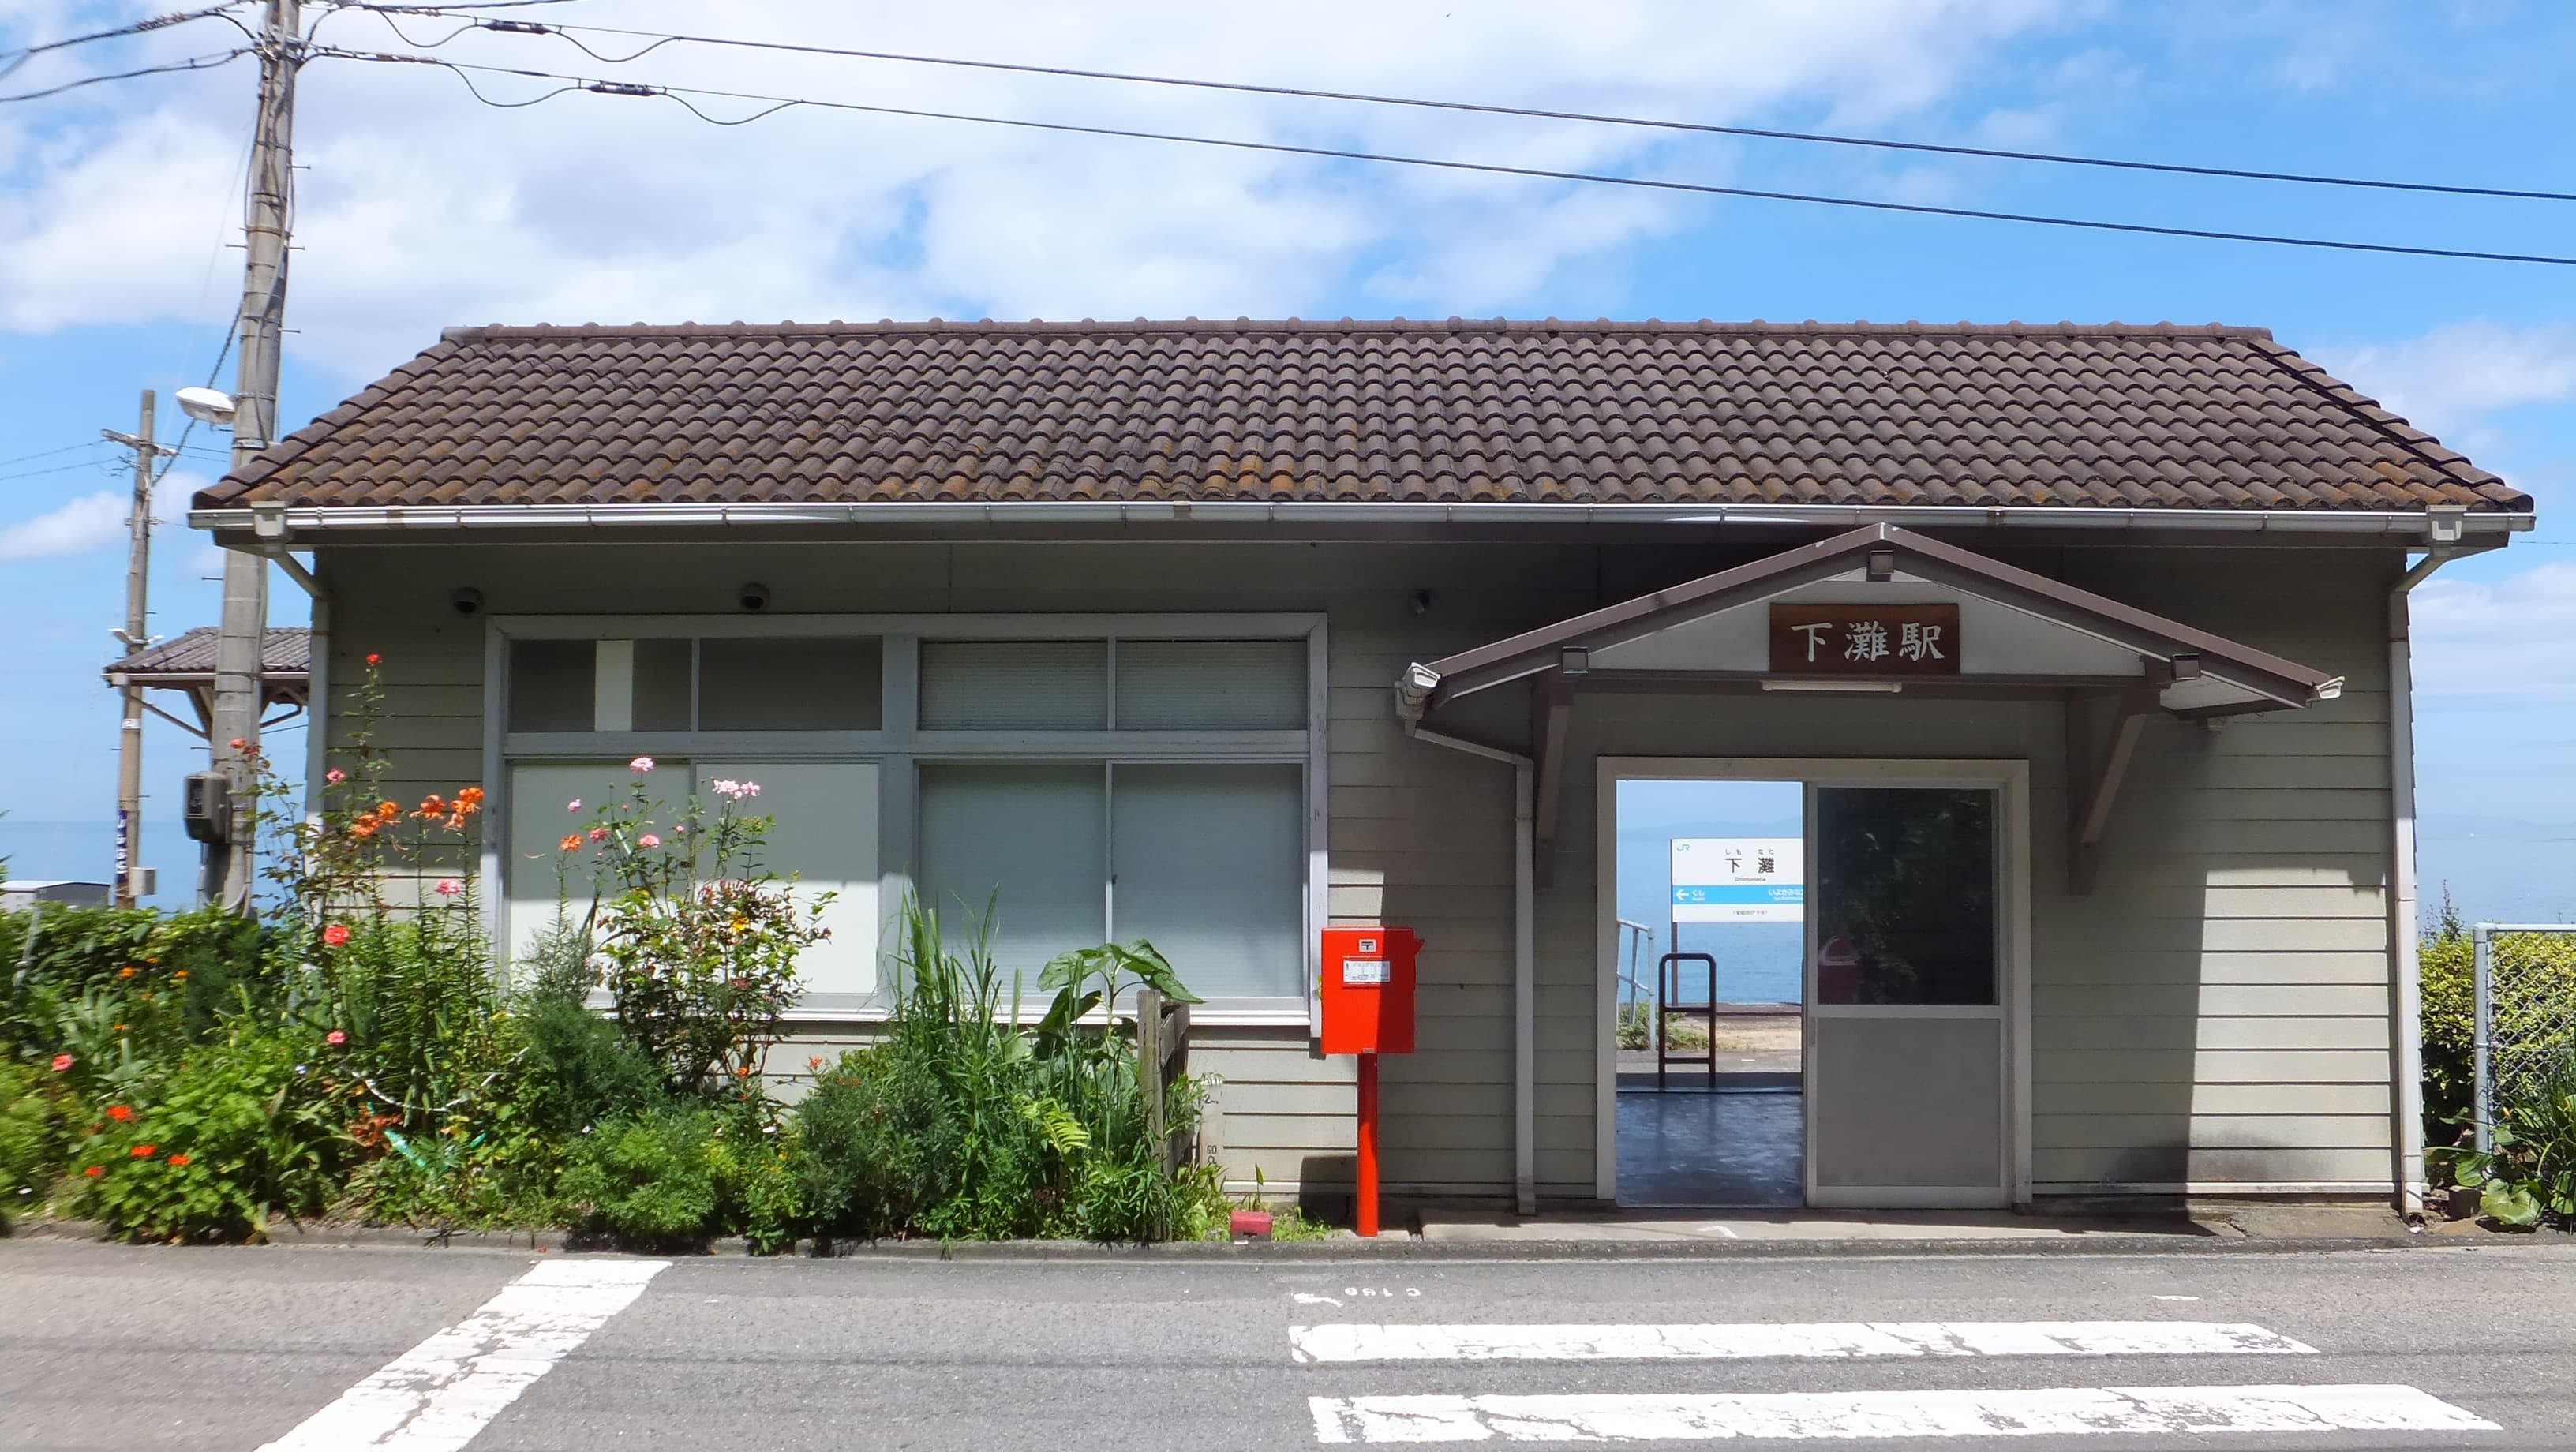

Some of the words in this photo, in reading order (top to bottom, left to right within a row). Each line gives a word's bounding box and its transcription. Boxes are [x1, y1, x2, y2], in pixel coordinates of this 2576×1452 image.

[1791, 620, 1945, 662] 下灘駅
[1725, 857, 1774, 874] 下灘
[1206, 1144, 1217, 1154] 50
